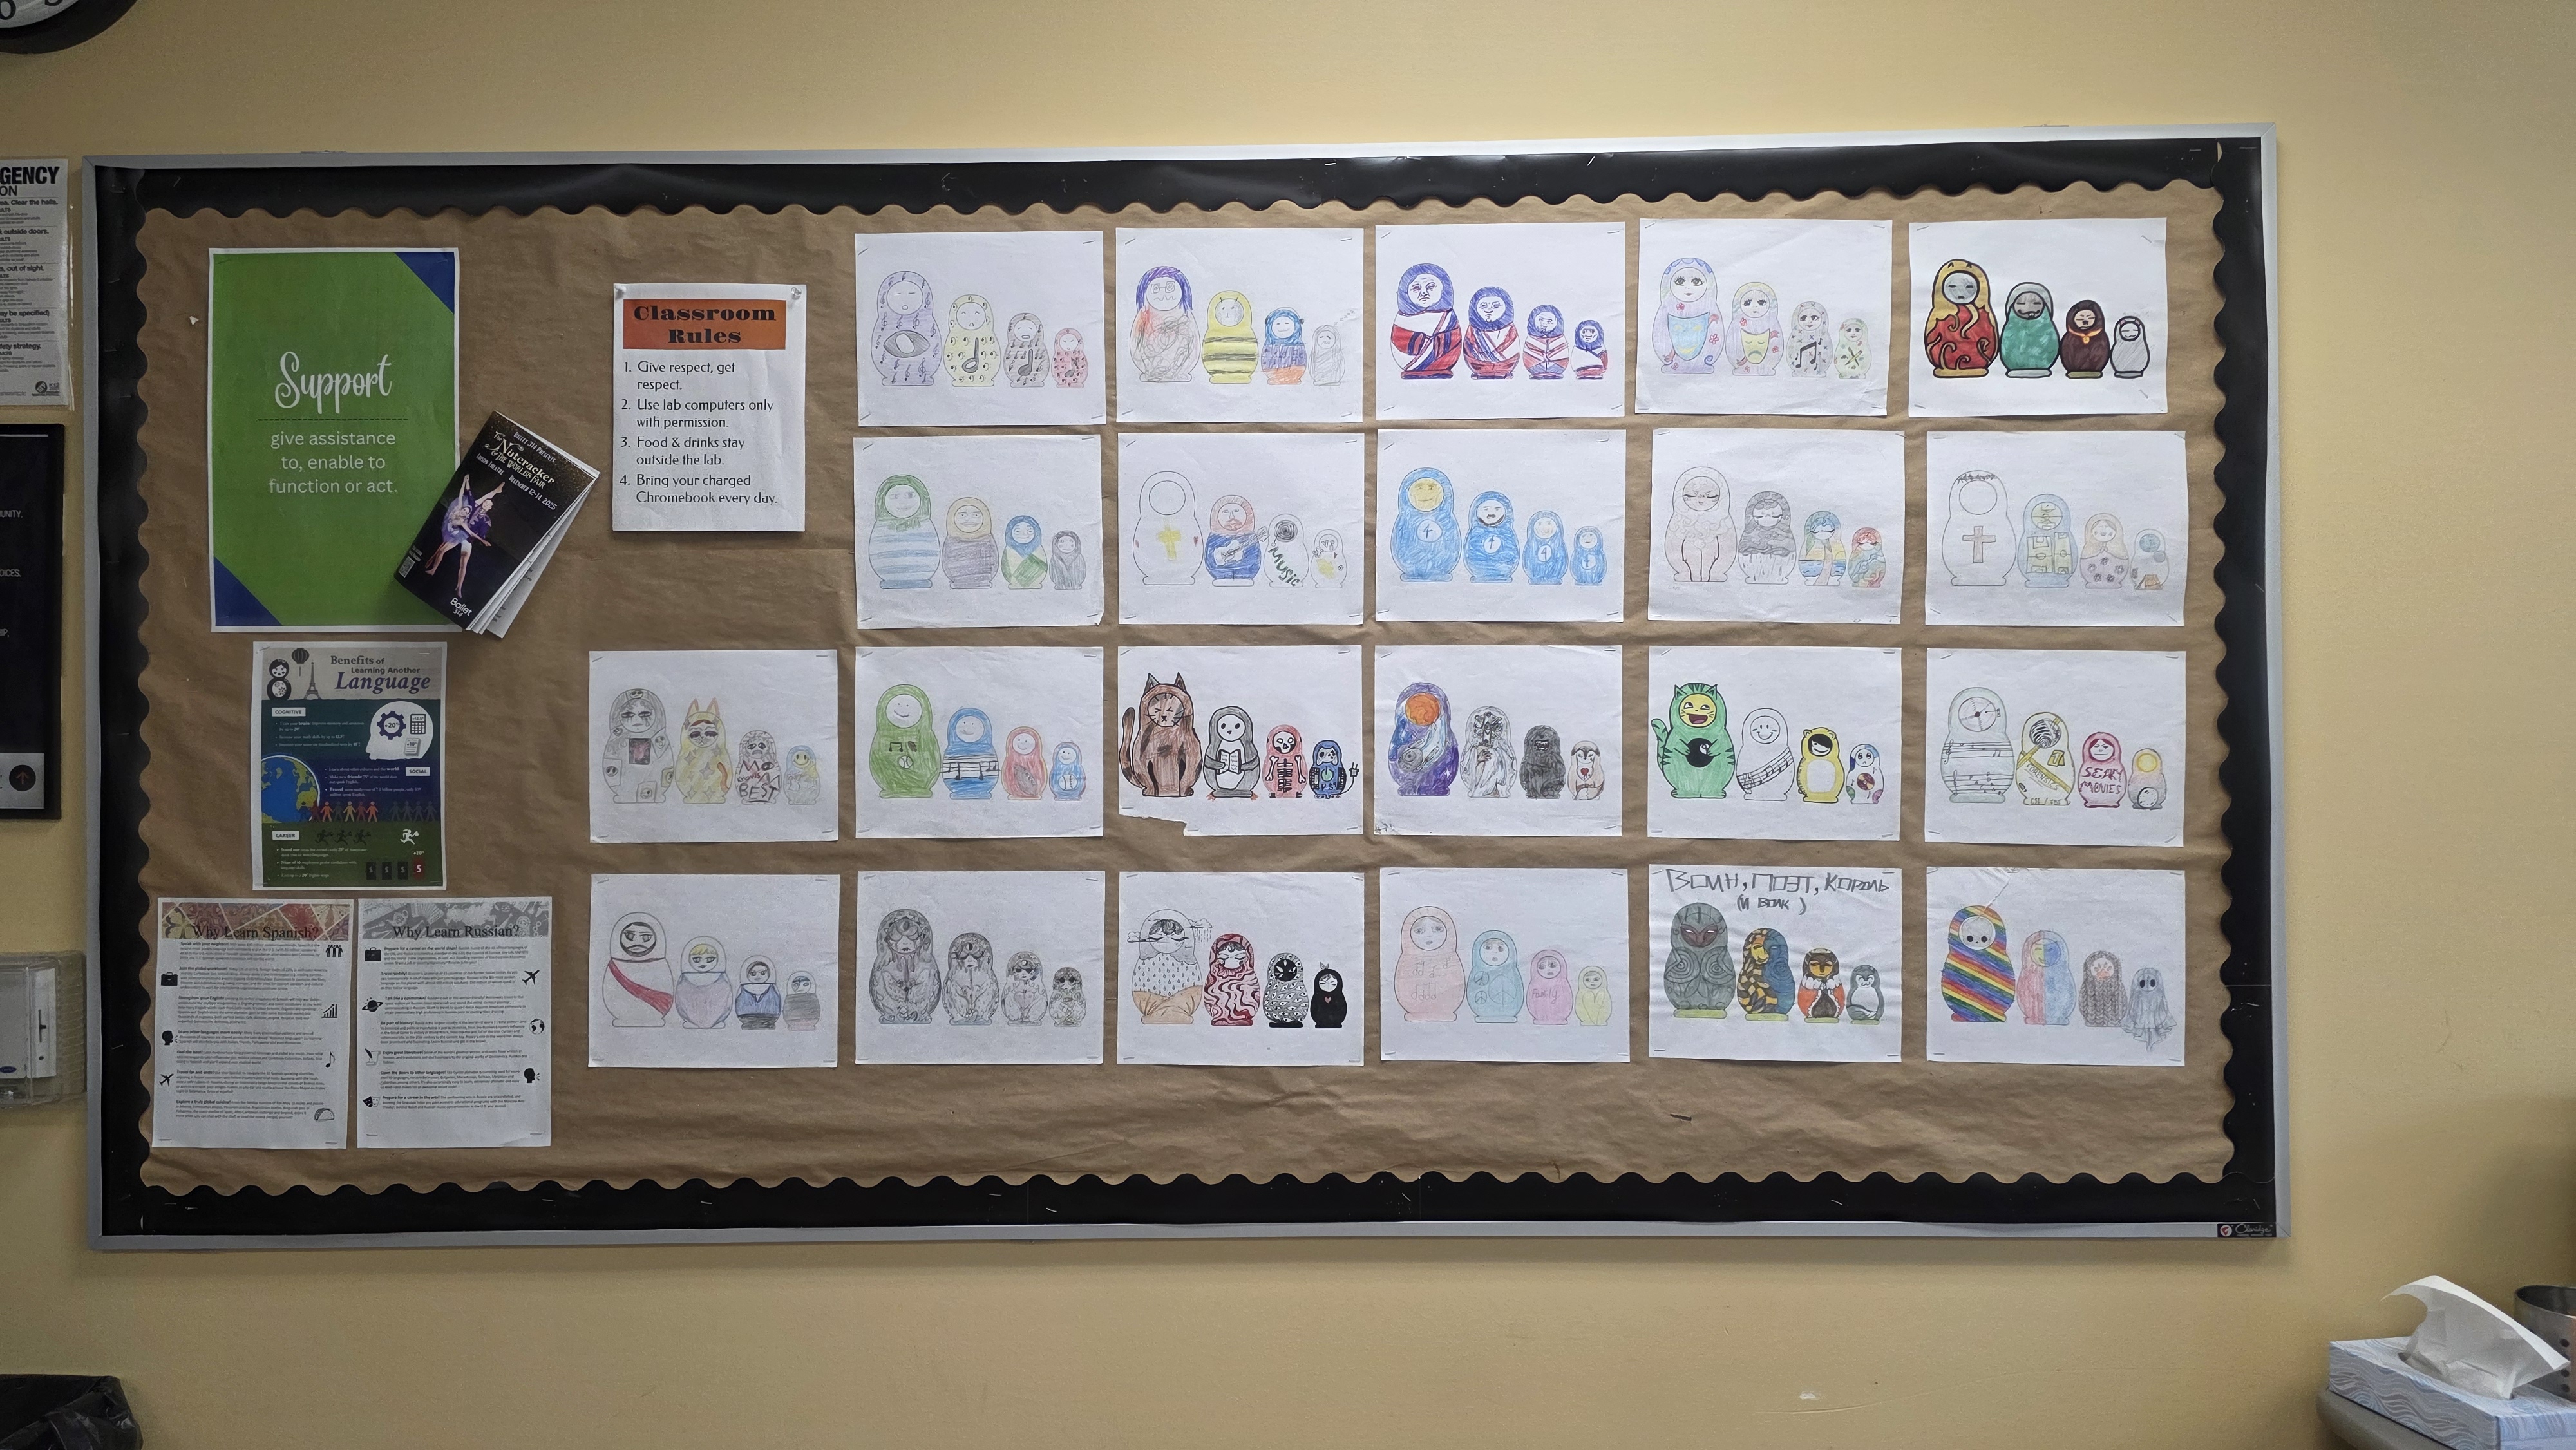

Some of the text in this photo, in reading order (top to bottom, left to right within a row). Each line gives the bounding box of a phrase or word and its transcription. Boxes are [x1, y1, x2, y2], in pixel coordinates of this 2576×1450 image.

[0, 166, 61, 185] GENCY
[634, 305, 776, 321] Classroom
[668, 328, 741, 343] Rules
[624, 361, 735, 375] 1. Give respect, get
[275, 352, 392, 414] Support
[638, 380, 682, 391] respect.
[621, 399, 774, 412] 2. Use lab computers only
[637, 417, 728, 429] with permission.
[270, 431, 396, 449] give assistance
[527, 440, 537, 450] 314
[621, 437, 744, 449] 3. Food & drinks stay
[281, 456, 386, 471] to, enable to
[484, 438, 554, 484] Nutcracker
[636, 454, 724, 465] outside the lab.
[269, 479, 398, 493] function or act.
[620, 475, 751, 487] 4. Bring your charged
[542, 498, 558, 510] 2025
[636, 491, 777, 505] Chromebook every day.
[450, 598, 473, 616] Ballet
[453, 608, 463, 617] 314
[331, 655, 374, 665] Benefits
[335, 672, 431, 694] Language
[739, 782, 780, 801] BEST
[2079, 780, 2121, 795] MOVIES
[193, 925, 319, 939] Why Learn Spanish?
[393, 925, 519, 939] Why Learn Russian?
[1533, 989, 1557, 1004] Family
[2235, 1223, 2272, 1234] Claridge
